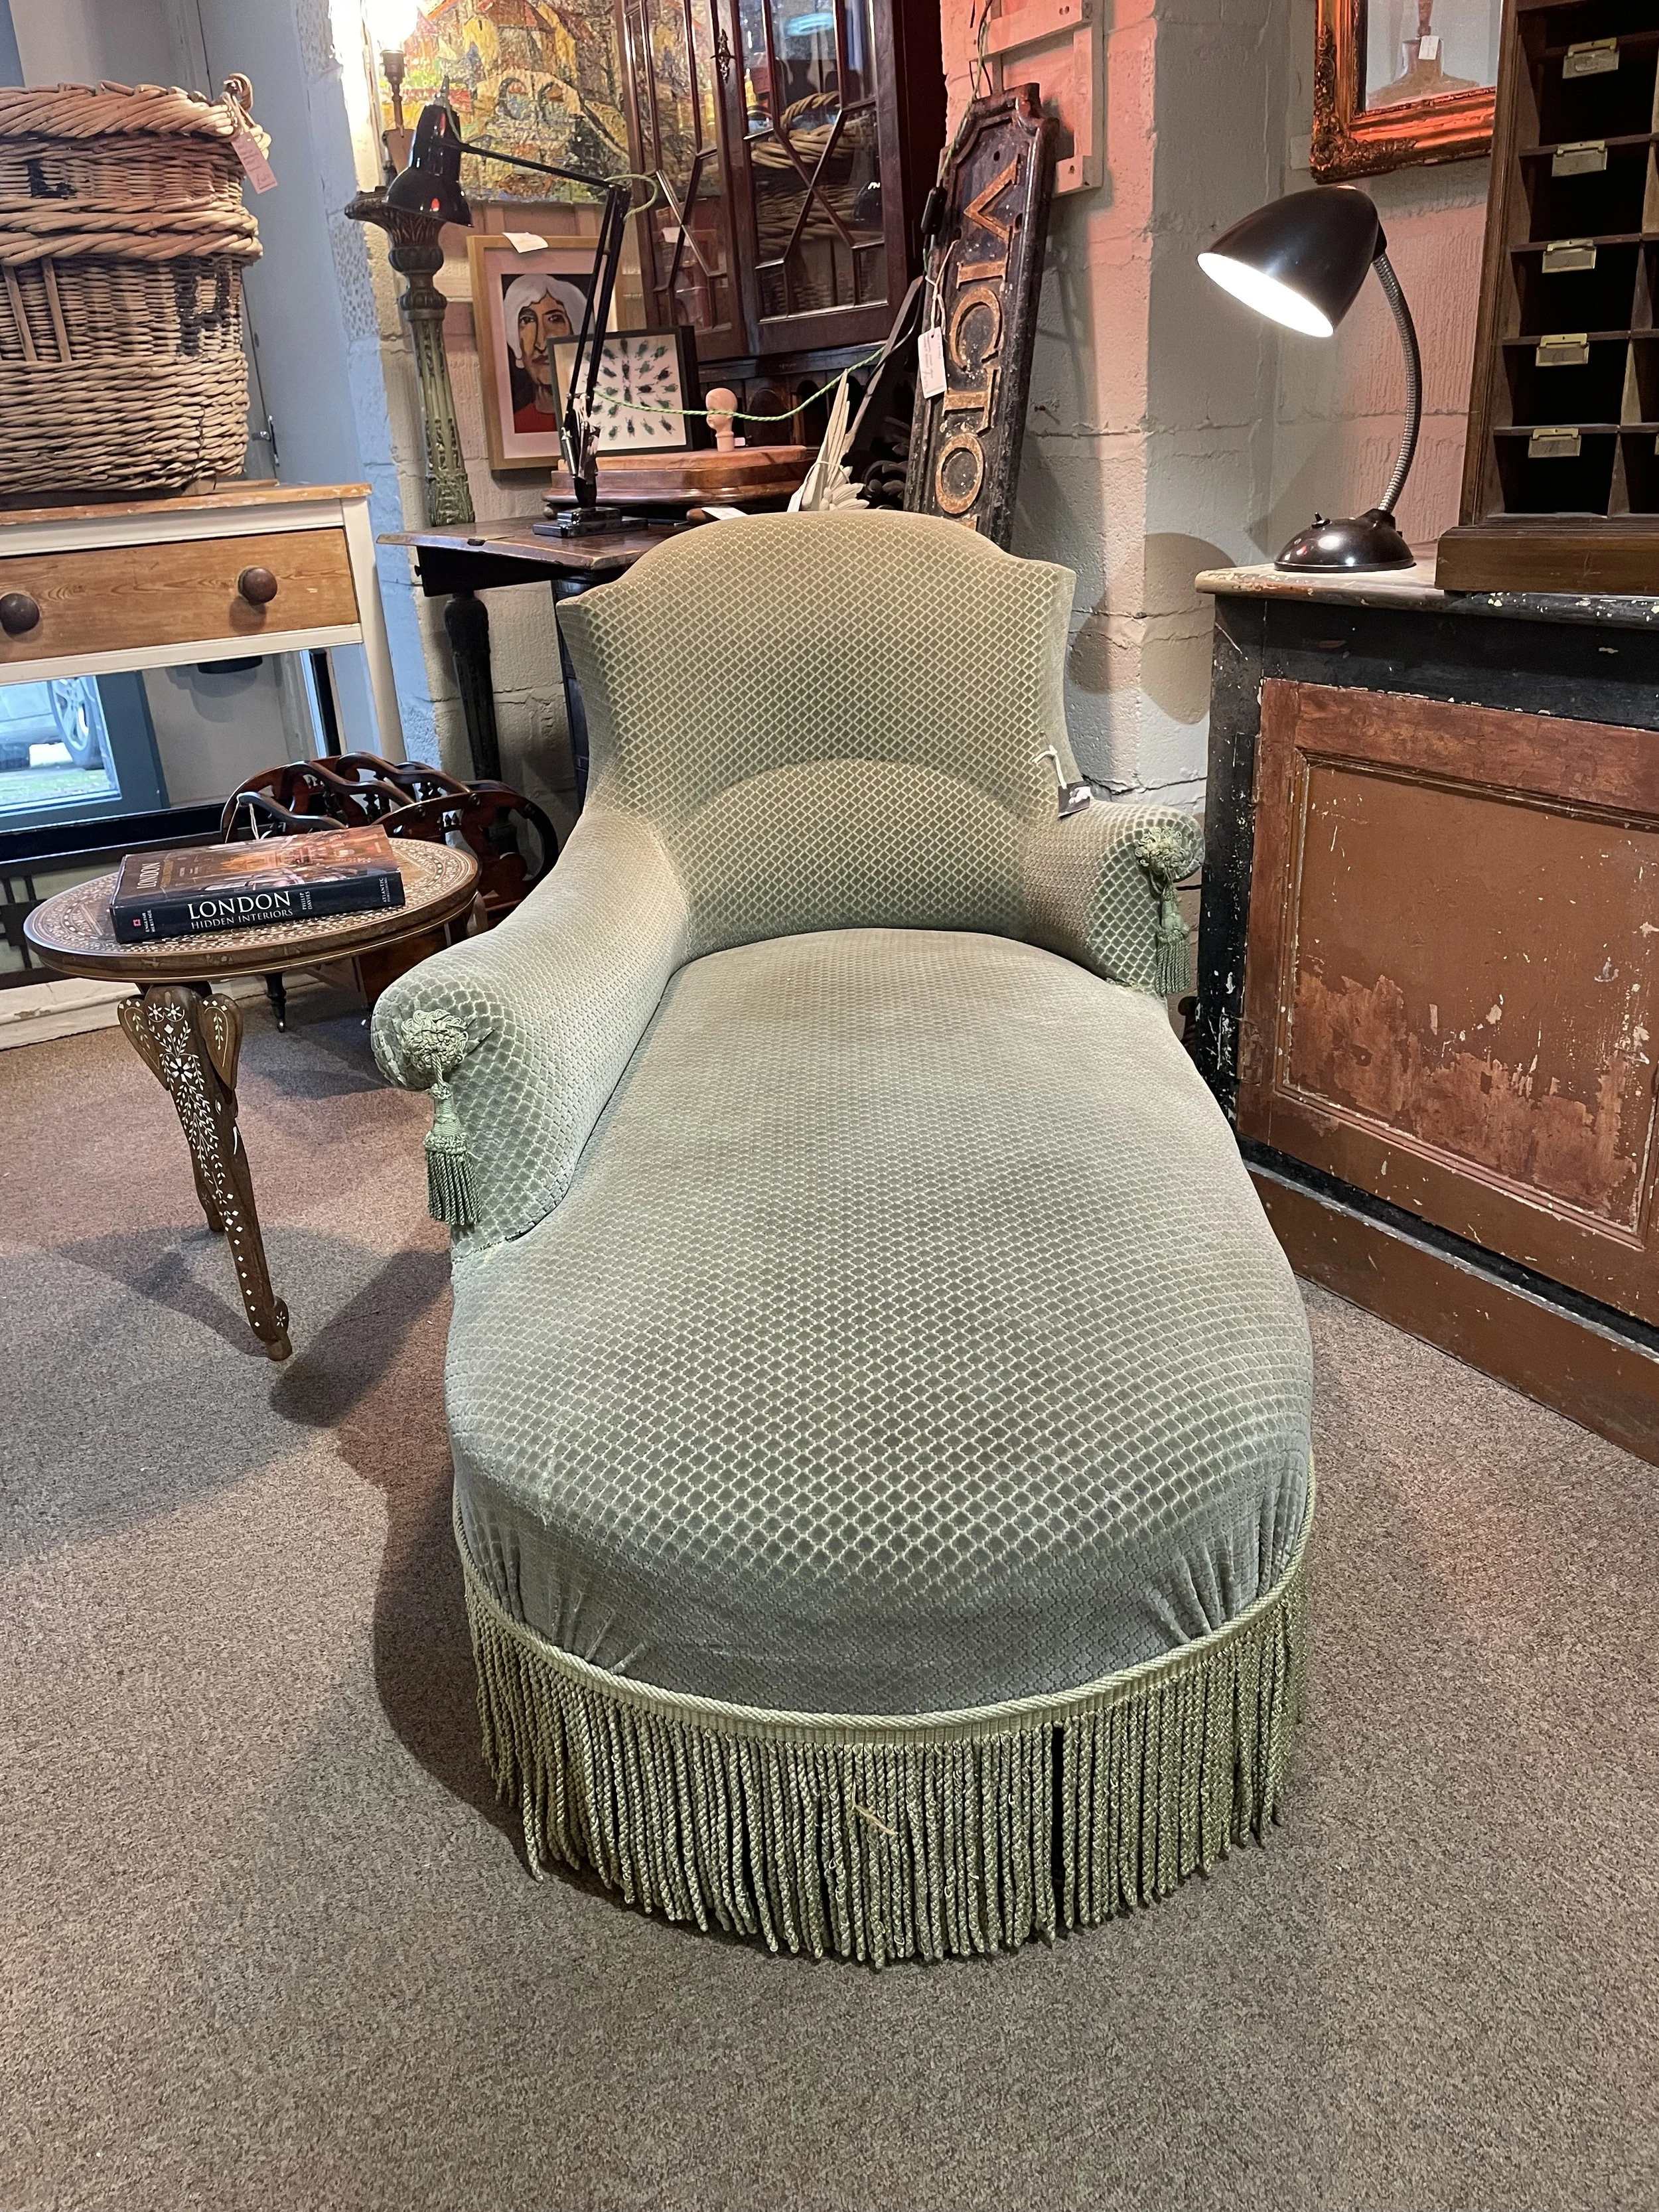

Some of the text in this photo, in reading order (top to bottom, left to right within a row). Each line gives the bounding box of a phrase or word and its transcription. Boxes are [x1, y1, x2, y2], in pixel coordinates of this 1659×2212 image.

[934, 153, 1019, 531] VICTO
[136, 862, 161, 889] LONDON
[187, 891, 291, 920] LONDON
[305, 891, 313, 911] DAVIES
[141, 913, 150, 932] ENGLISH
[147, 909, 156, 932] HERITAGE
[191, 909, 293, 930] HIDDEN INTERIORS
